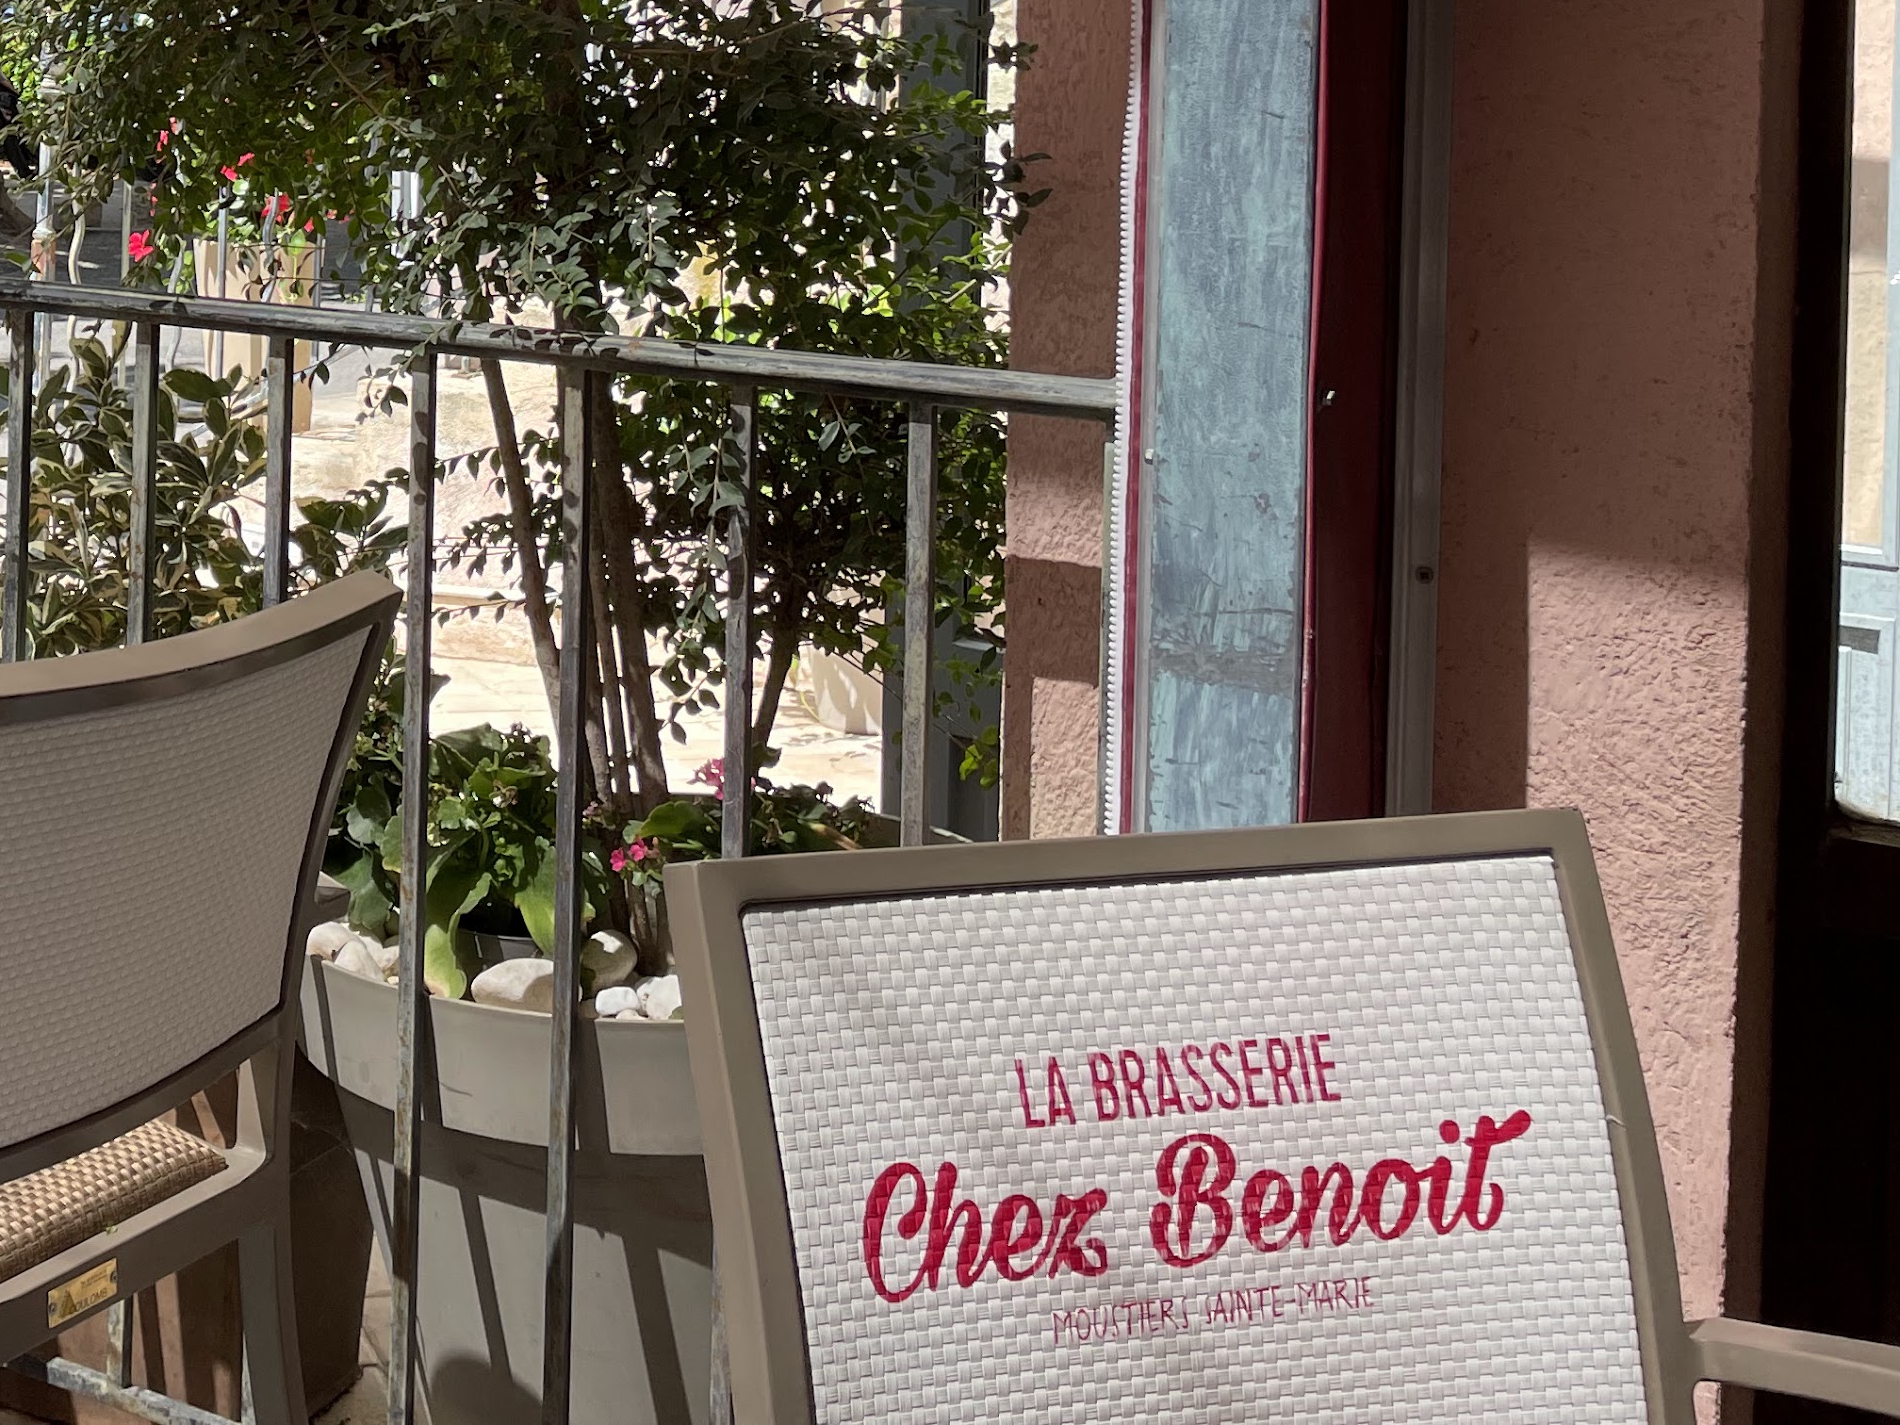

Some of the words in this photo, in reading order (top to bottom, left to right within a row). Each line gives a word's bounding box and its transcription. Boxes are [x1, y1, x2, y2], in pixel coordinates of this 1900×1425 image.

[1015, 1057, 1076, 1128] LA
[1088, 1034, 1342, 1122] BRASSERIE
[863, 1161, 1110, 1303] Chez
[1149, 1109, 1533, 1268] Benoit
